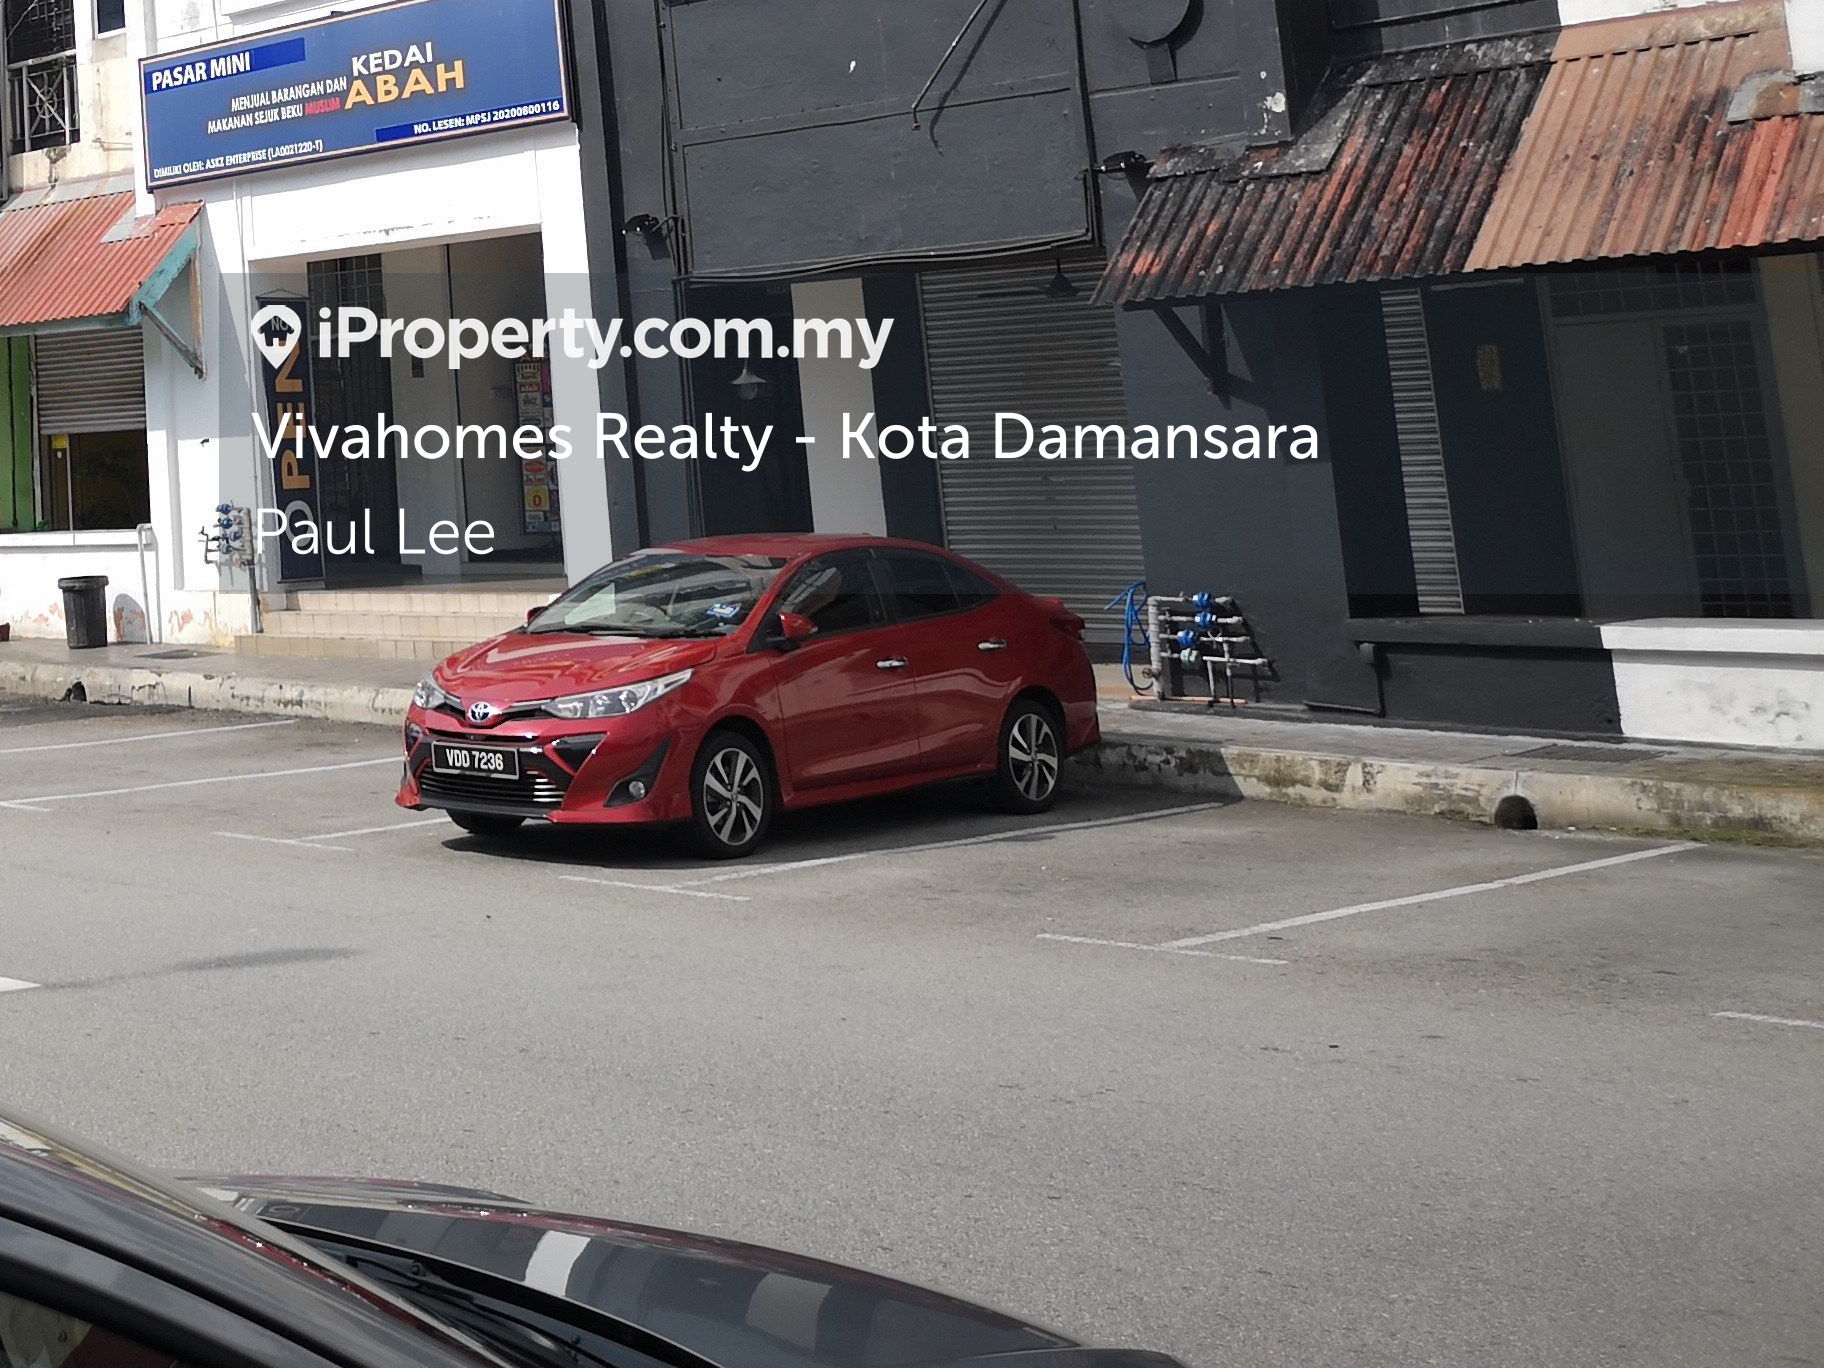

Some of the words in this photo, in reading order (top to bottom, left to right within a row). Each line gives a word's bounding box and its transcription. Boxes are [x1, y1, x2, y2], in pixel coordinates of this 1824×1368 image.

[151, 61, 207, 91] PASAR
[209, 51, 251, 79] MINI
[352, 41, 434, 77] KEDAI
[231, 95, 271, 112] MENJUAL
[271, 80, 325, 105] BARANGAN
[325, 76, 347, 94] DAN
[344, 60, 465, 110] ABAH
[208, 113, 253, 134] MAKANAN
[254, 108, 280, 125] SEJUK
[281, 104, 304, 120] BEKU
[414, 124, 431, 134] NO.
[466, 112, 491, 126] MPSJ
[226, 148, 267, 166] ENTERPRISE
[445, 747, 470, 768] VDD
[473, 750, 504, 771] 7236
